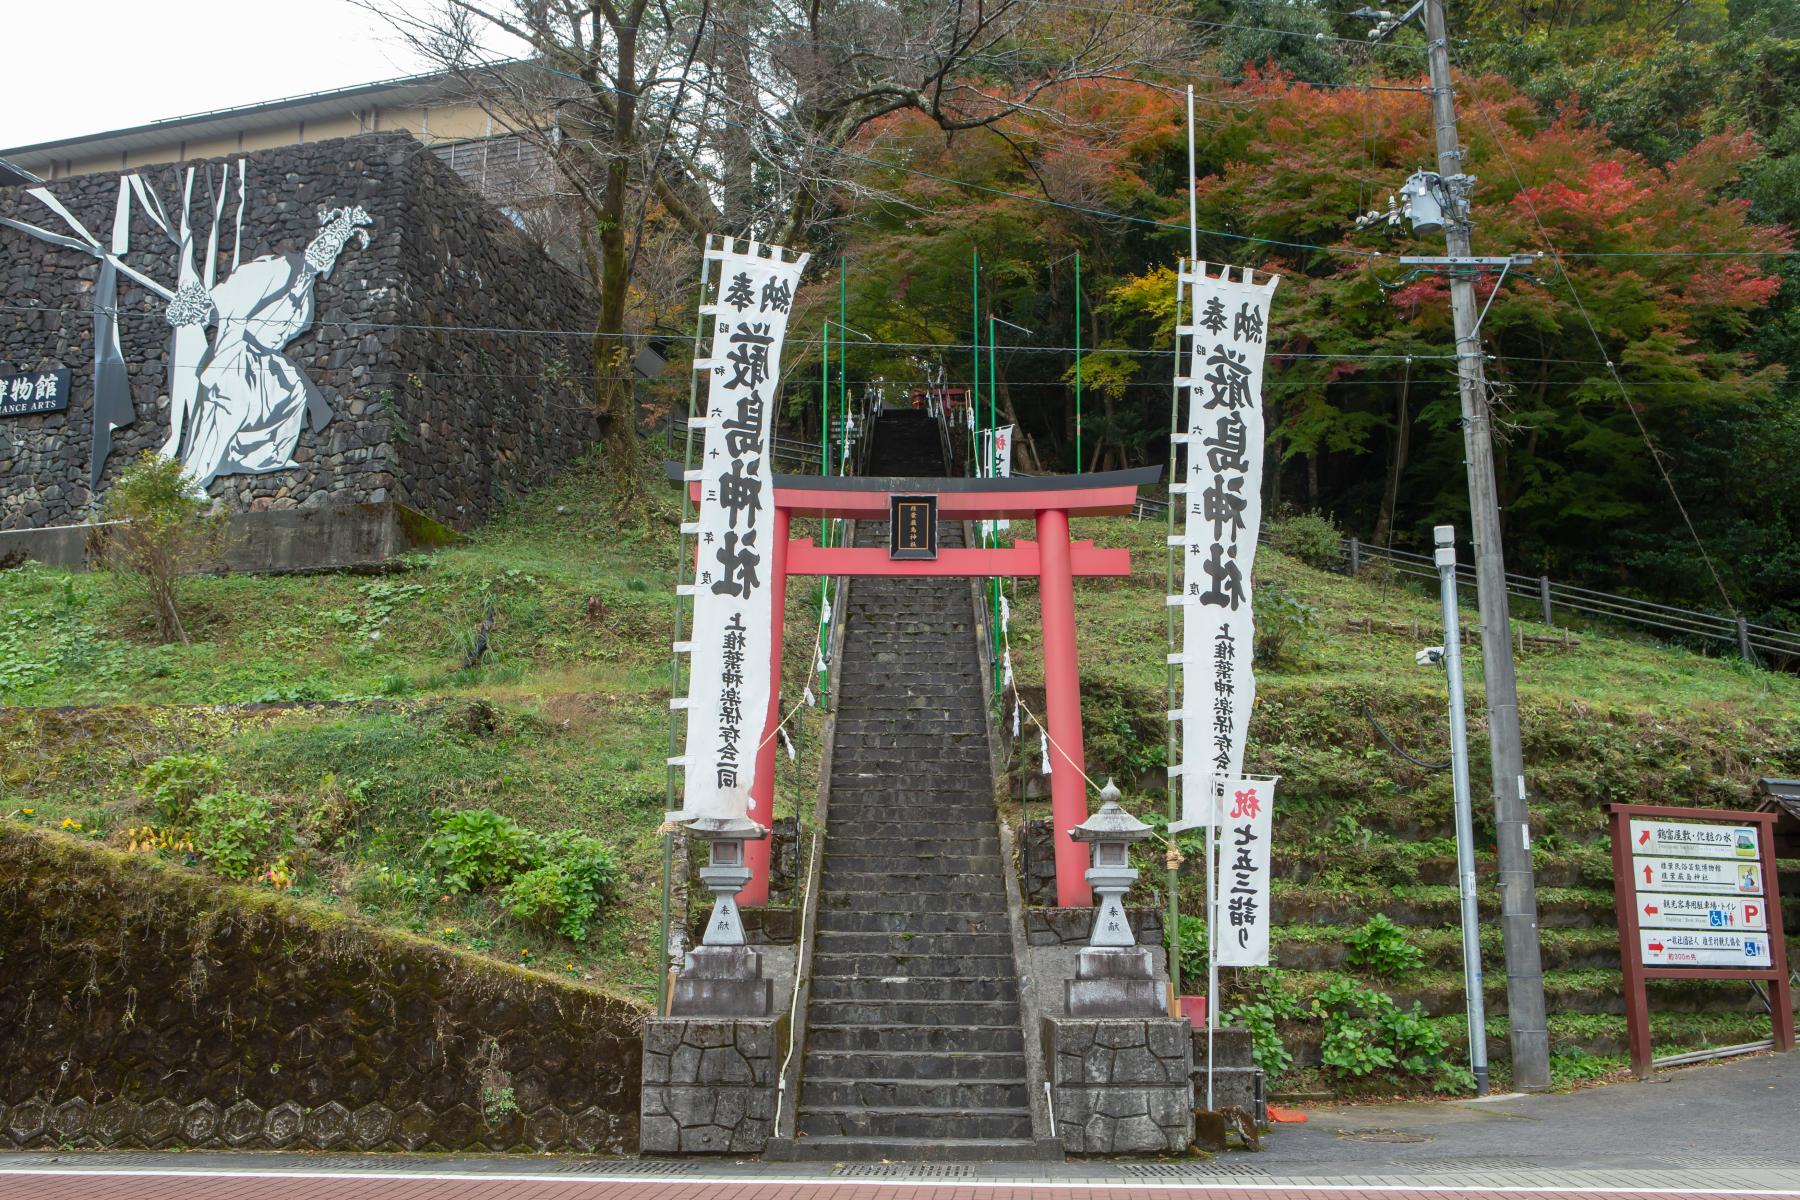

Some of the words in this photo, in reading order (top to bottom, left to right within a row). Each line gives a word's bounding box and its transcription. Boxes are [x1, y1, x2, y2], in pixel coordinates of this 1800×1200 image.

[0, 403, 28, 414] ANCE
[30, 399, 57, 411] ARTS
[717, 904, 730, 931] 奉献
[1107, 906, 1121, 932] 奉献
[1744, 904, 1759, 924] P
[1667, 952, 1697, 962] 約300m先
